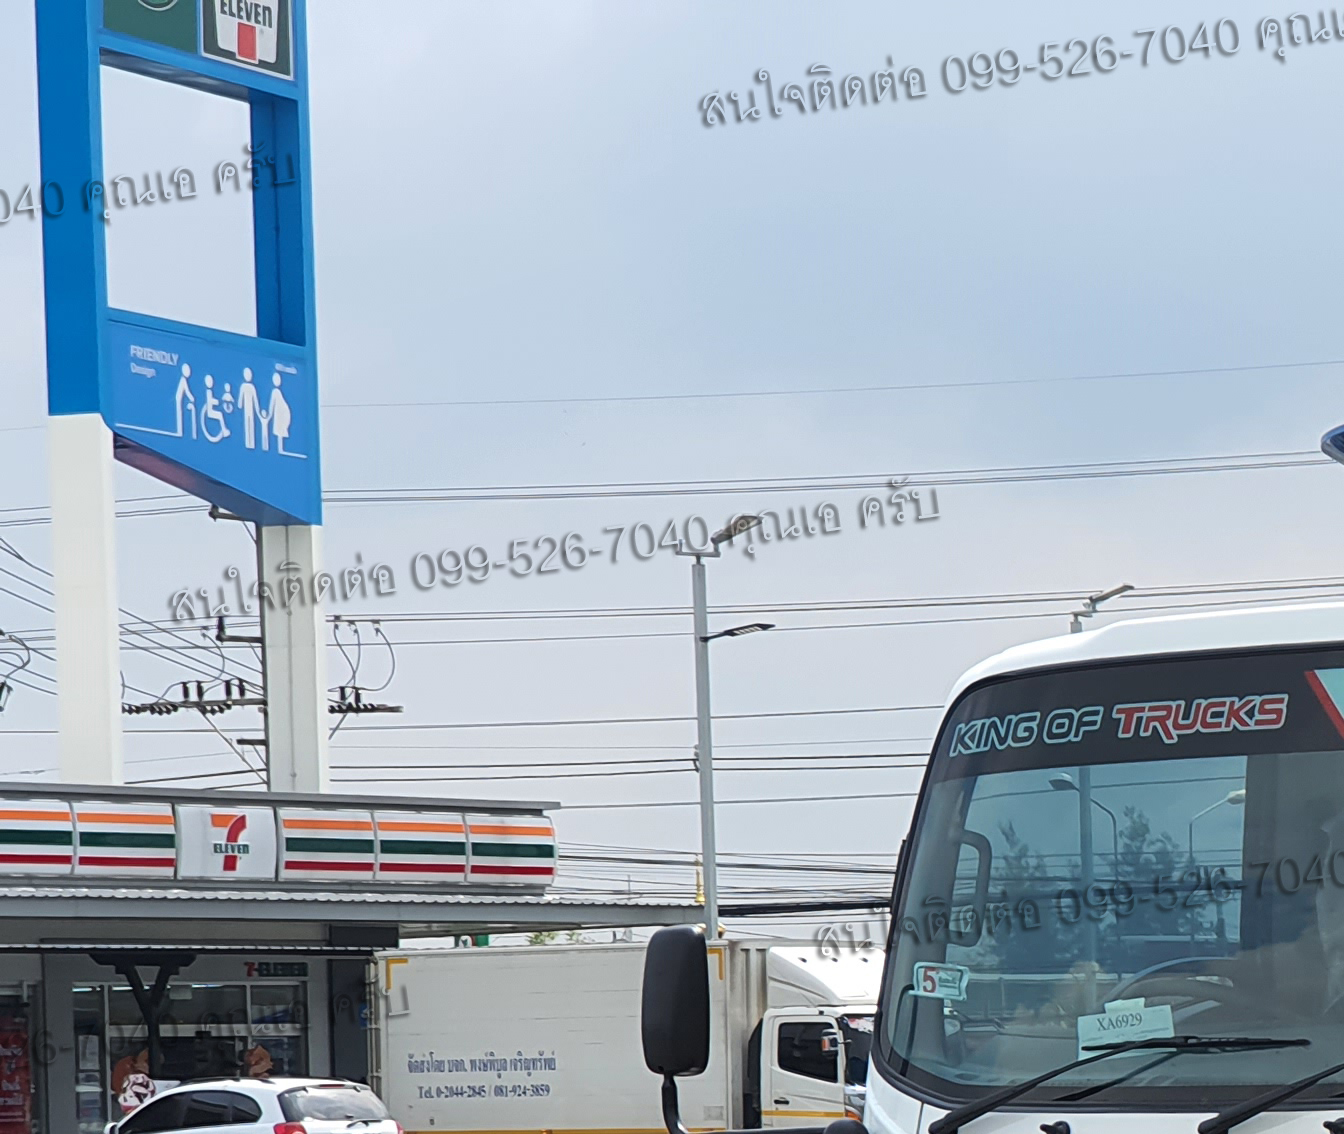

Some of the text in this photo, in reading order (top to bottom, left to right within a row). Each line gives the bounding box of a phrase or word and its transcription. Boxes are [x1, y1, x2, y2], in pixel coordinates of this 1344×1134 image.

[130, 345, 179, 366] FRIENDLY
[949, 694, 1289, 757] KING OF TRUCKS
[1097, 1011, 1142, 1031] XA6929
